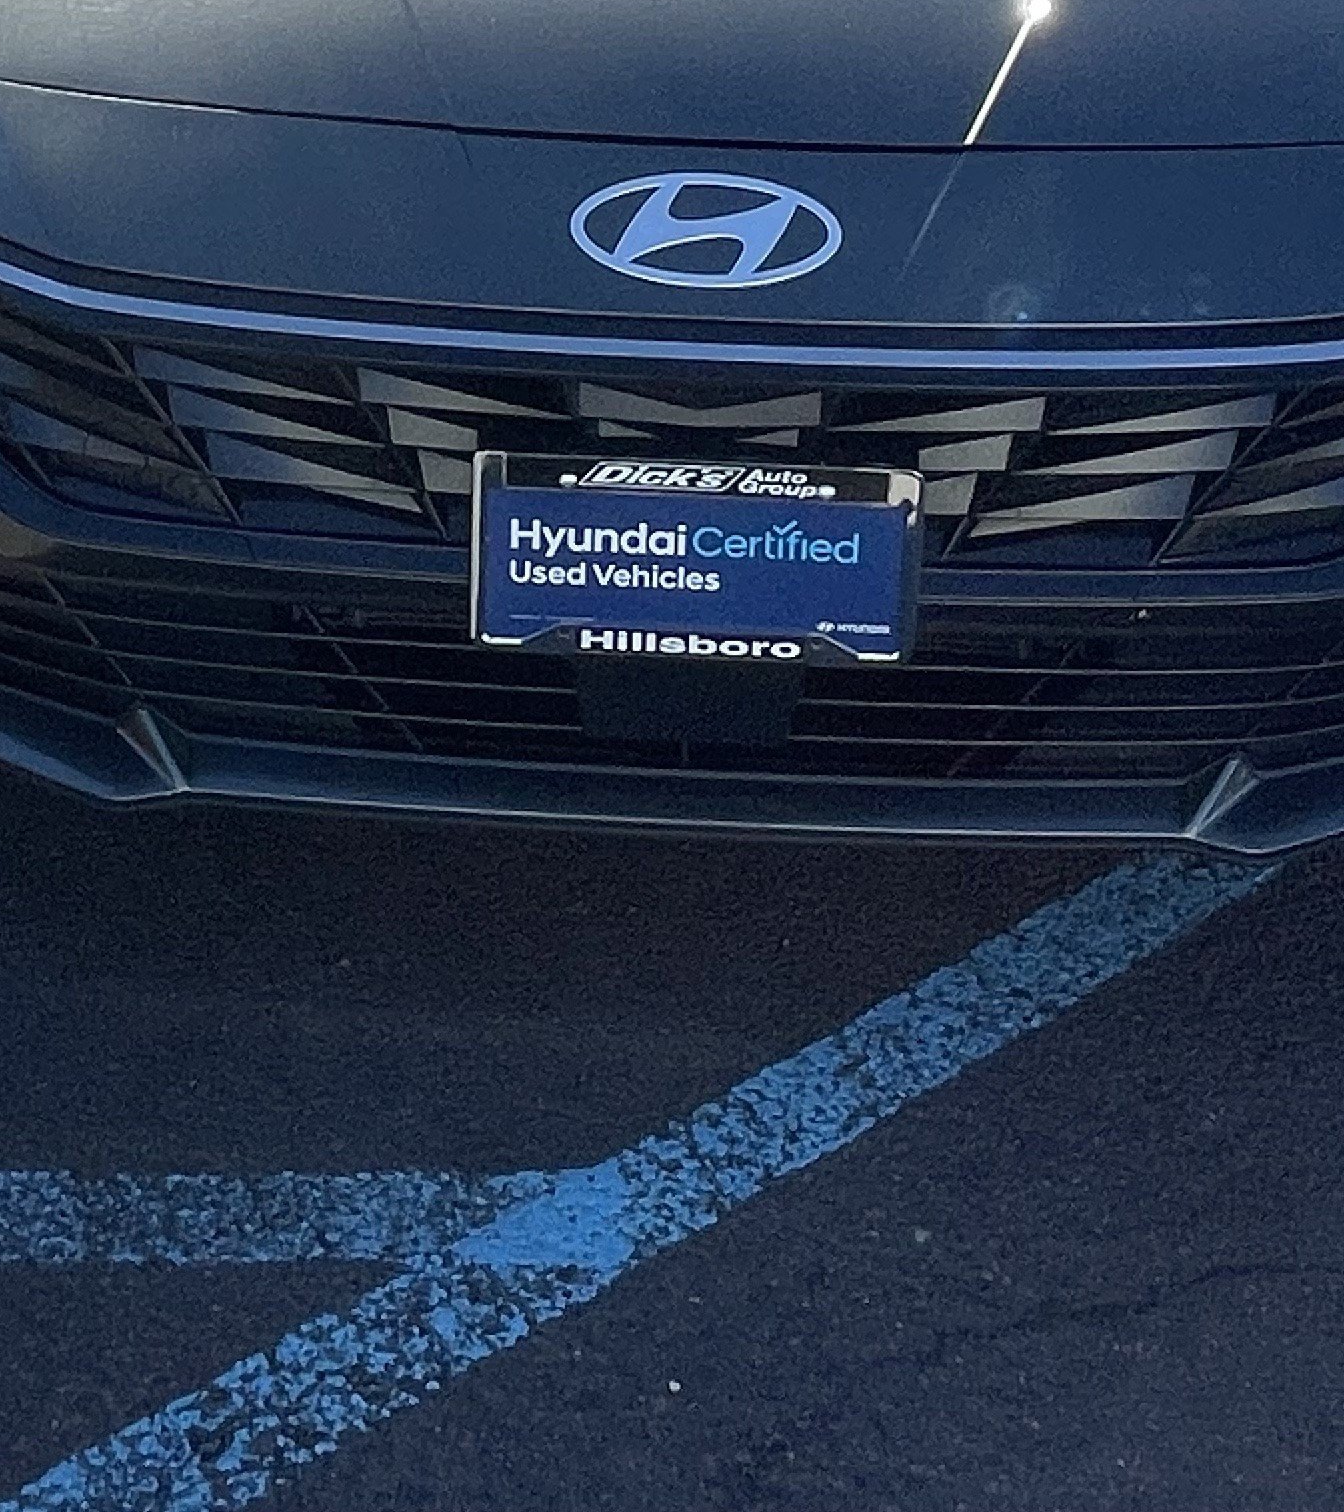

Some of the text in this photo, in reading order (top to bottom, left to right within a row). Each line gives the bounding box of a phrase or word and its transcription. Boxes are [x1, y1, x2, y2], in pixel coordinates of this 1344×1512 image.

[739, 480, 816, 499] Group
[748, 468, 808, 484] Auto
[510, 518, 860, 564] Hyundai Certified
[510, 559, 721, 591] Used Vehicles
[580, 629, 802, 658] Hillsboro
